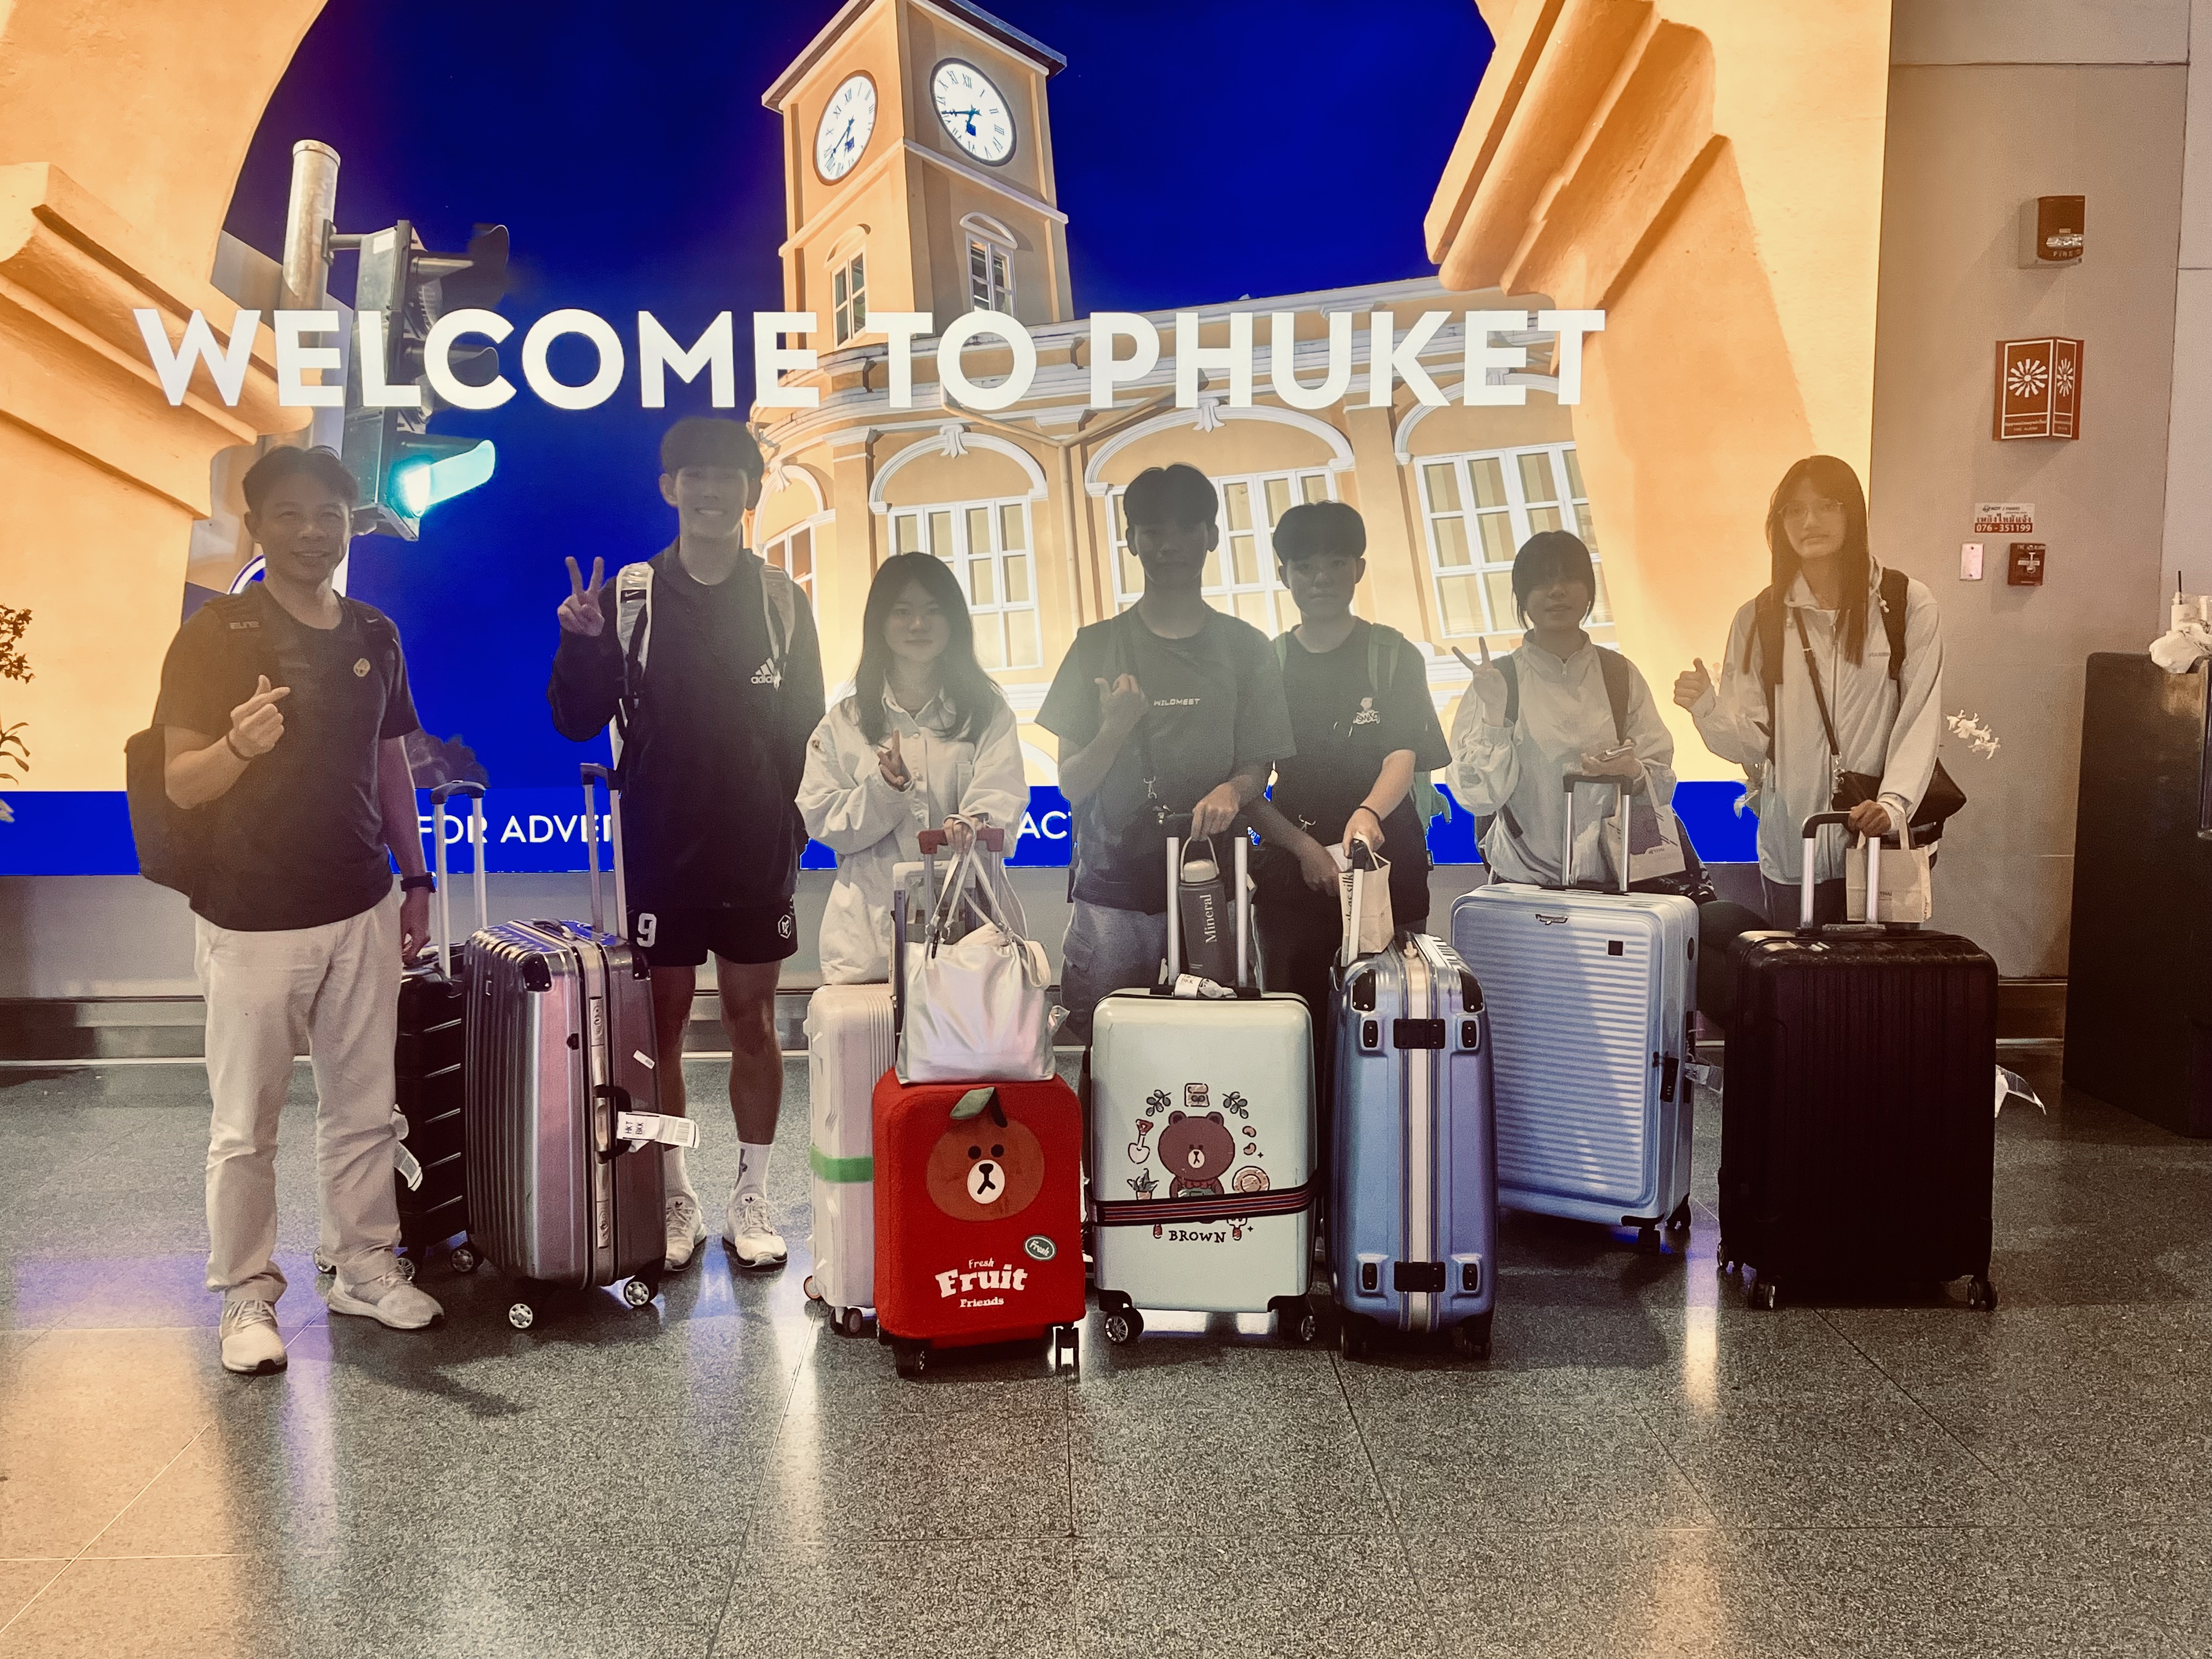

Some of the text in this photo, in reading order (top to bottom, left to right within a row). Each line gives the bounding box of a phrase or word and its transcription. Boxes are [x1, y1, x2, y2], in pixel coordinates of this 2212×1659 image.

[962, 73, 972, 89] XII
[132, 308, 1606, 410] WELCOME TO PHUKET
[417, 815, 488, 844] FOR
[1015, 810, 1071, 839] AC
[636, 913, 657, 947] 9
[1199, 894, 1217, 944] Mineral
[1029, 1240, 1050, 1256] Fresh
[1169, 1230, 1227, 1243] BROWN
[968, 1257, 995, 1269] Fresh
[934, 1263, 1029, 1298] Fruit
[960, 1296, 1005, 1308] Friends
